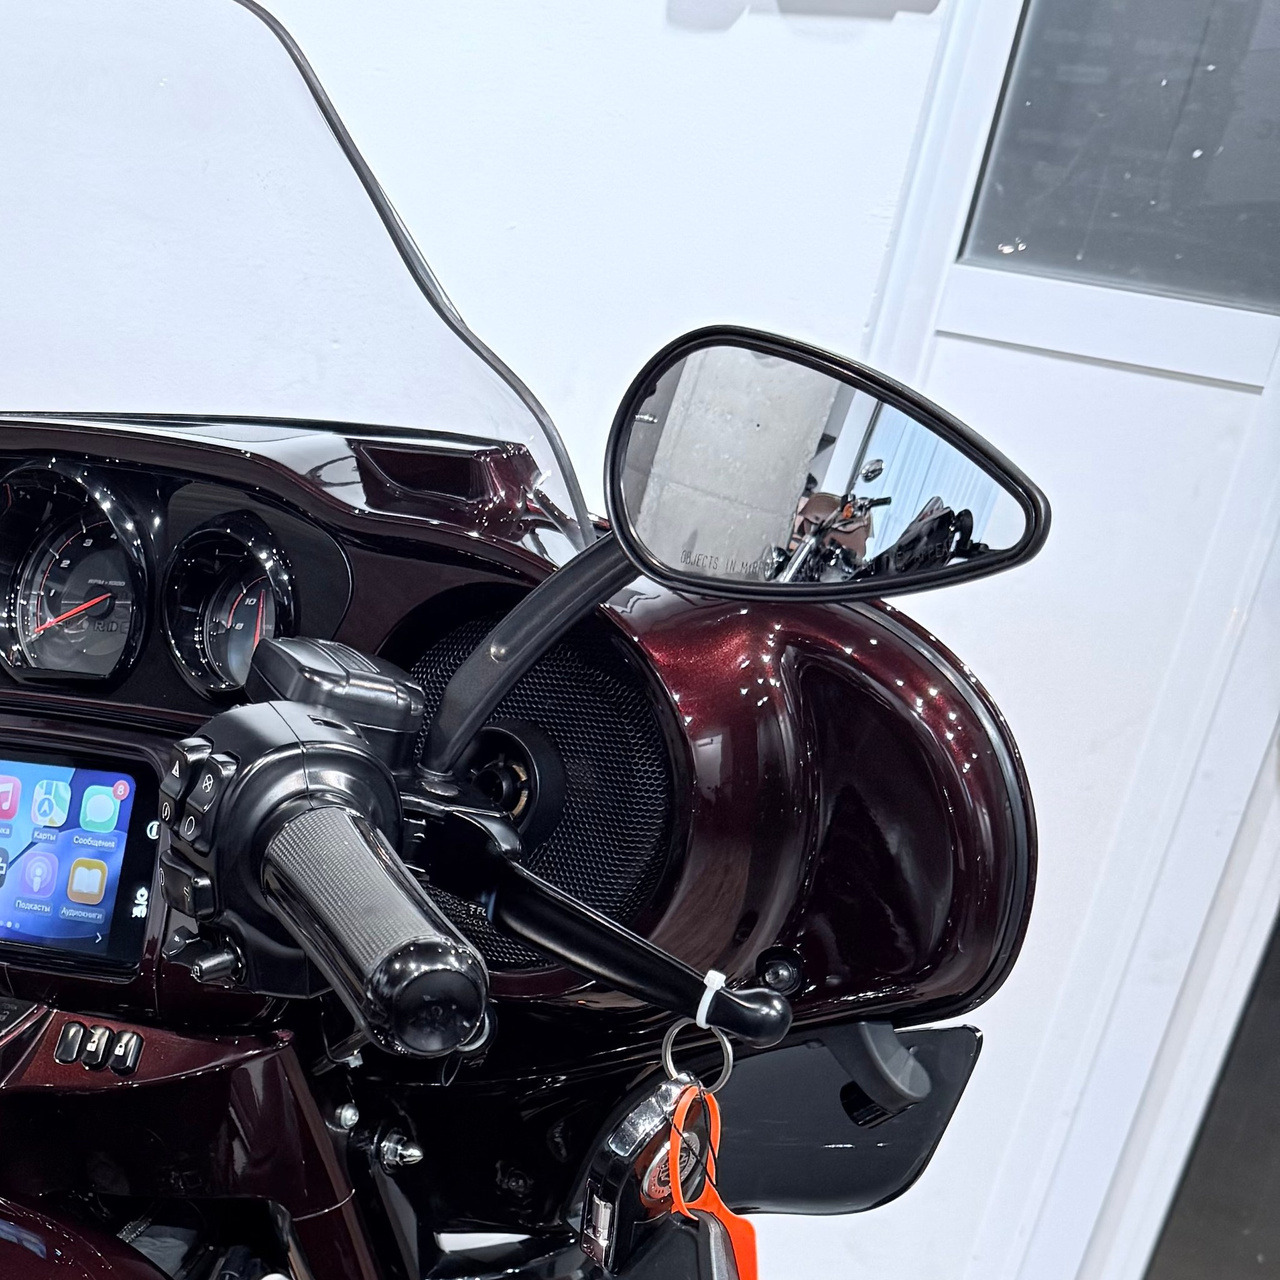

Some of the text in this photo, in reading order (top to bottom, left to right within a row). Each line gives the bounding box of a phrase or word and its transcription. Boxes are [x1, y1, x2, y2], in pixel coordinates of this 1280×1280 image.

[82, 538, 94, 547] 3
[60, 559, 71, 568] 2
[680, 550, 720, 570] OBJECTS
[725, 558, 736, 573] IN
[49, 588, 56, 597] 1
[244, 598, 257, 606] 10
[117, 784, 124, 796] 8
[33, 830, 57, 842] Карты
[73, 835, 116, 849] Сообщения
[15, 900, 51, 913] Подкасты
[61, 907, 103, 921] Аудиокниги
